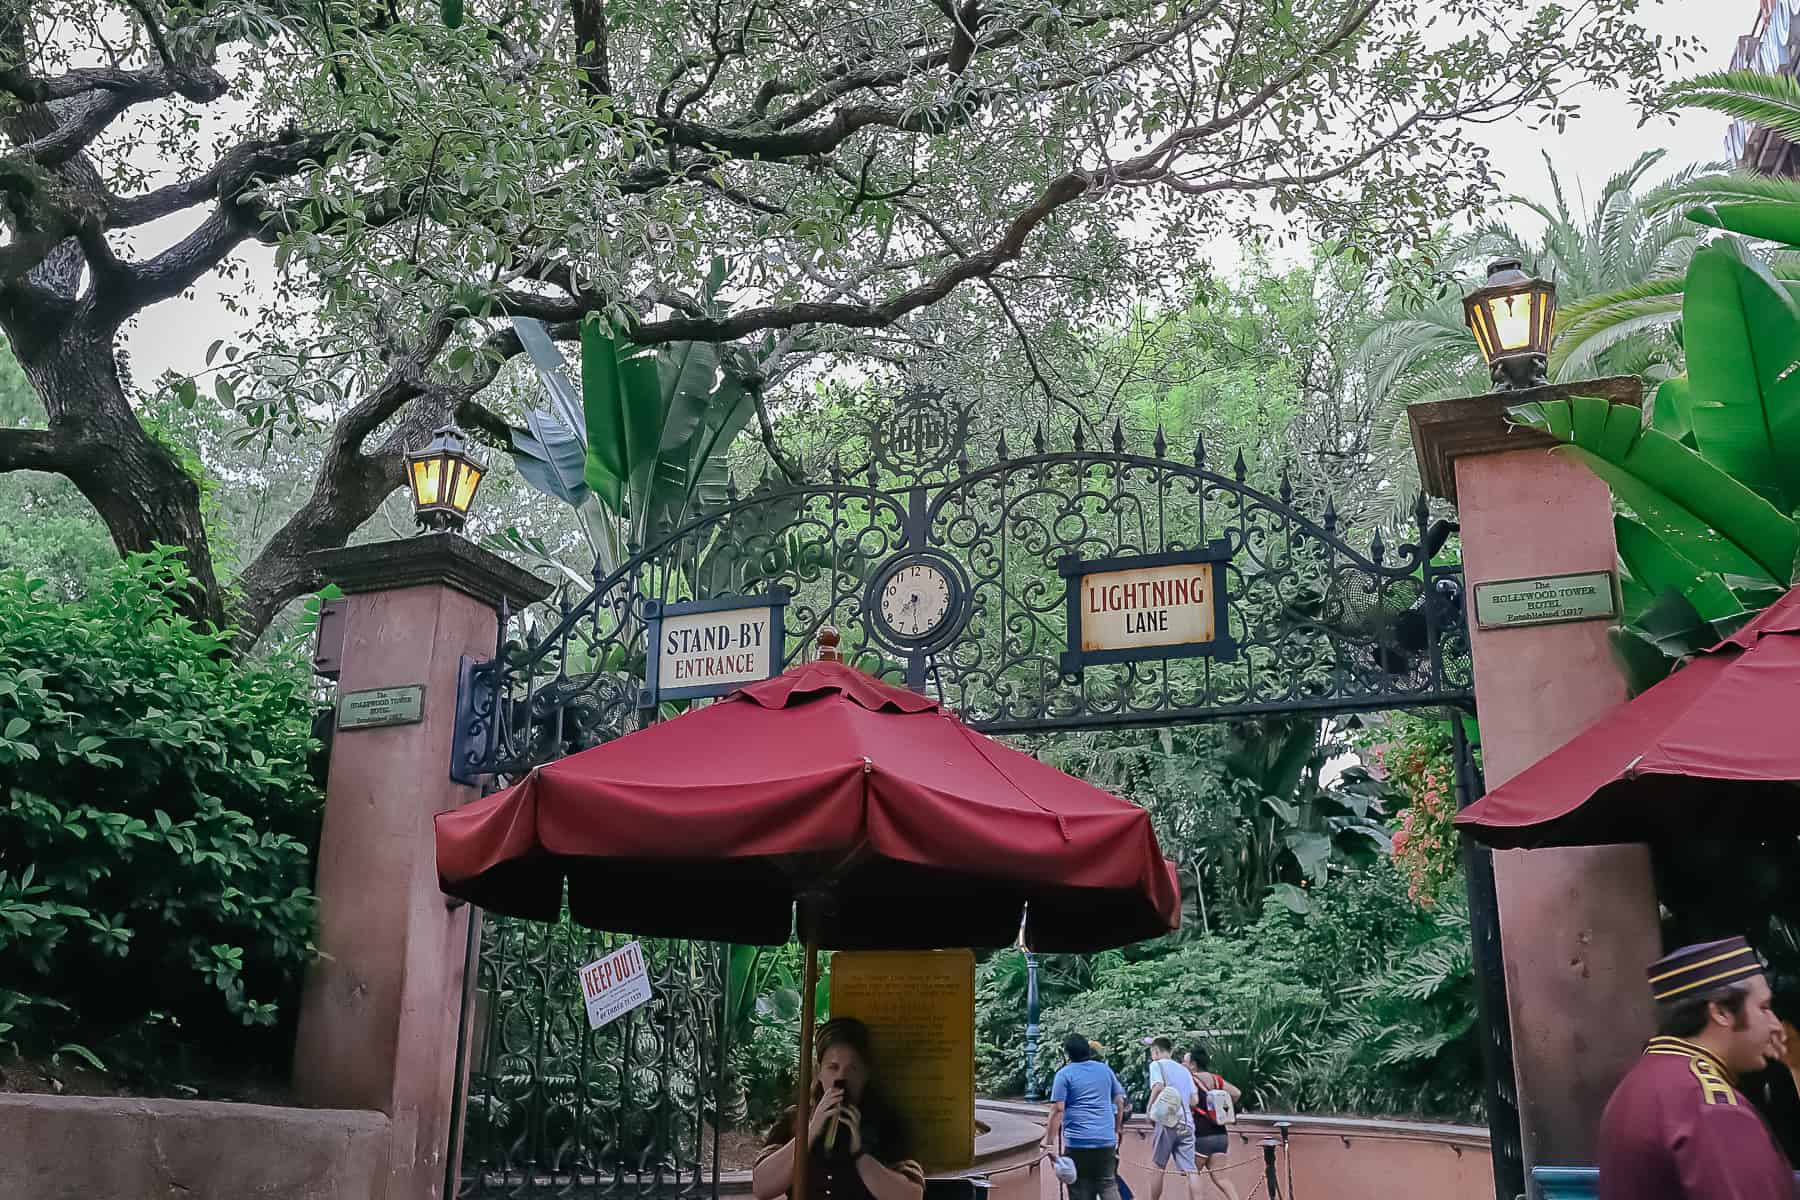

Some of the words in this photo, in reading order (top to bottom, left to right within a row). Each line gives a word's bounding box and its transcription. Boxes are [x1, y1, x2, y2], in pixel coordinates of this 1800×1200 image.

[910, 566, 921, 577] 12
[928, 569, 933, 579] 1
[896, 572, 904, 584] 11
[938, 579, 945, 589] 2
[886, 586, 897, 597] 10
[1090, 577, 1204, 613] LIGHTNING
[1492, 590, 1557, 604] HOLLYWOOD
[1560, 586, 1597, 598] TOWER
[942, 593, 949, 603] 3
[883, 600, 889, 610] 9
[1527, 599, 1562, 610] HOTEL
[937, 608, 944, 616] 4
[887, 613, 894, 623] 8
[1126, 610, 1168, 634] LANE
[899, 622, 905, 633] 7
[667, 621, 766, 655] STAND-BY
[675, 653, 755, 679] ENTRANCE
[584, 962, 612, 998] KEEP
[613, 946, 642, 982] OUT!
